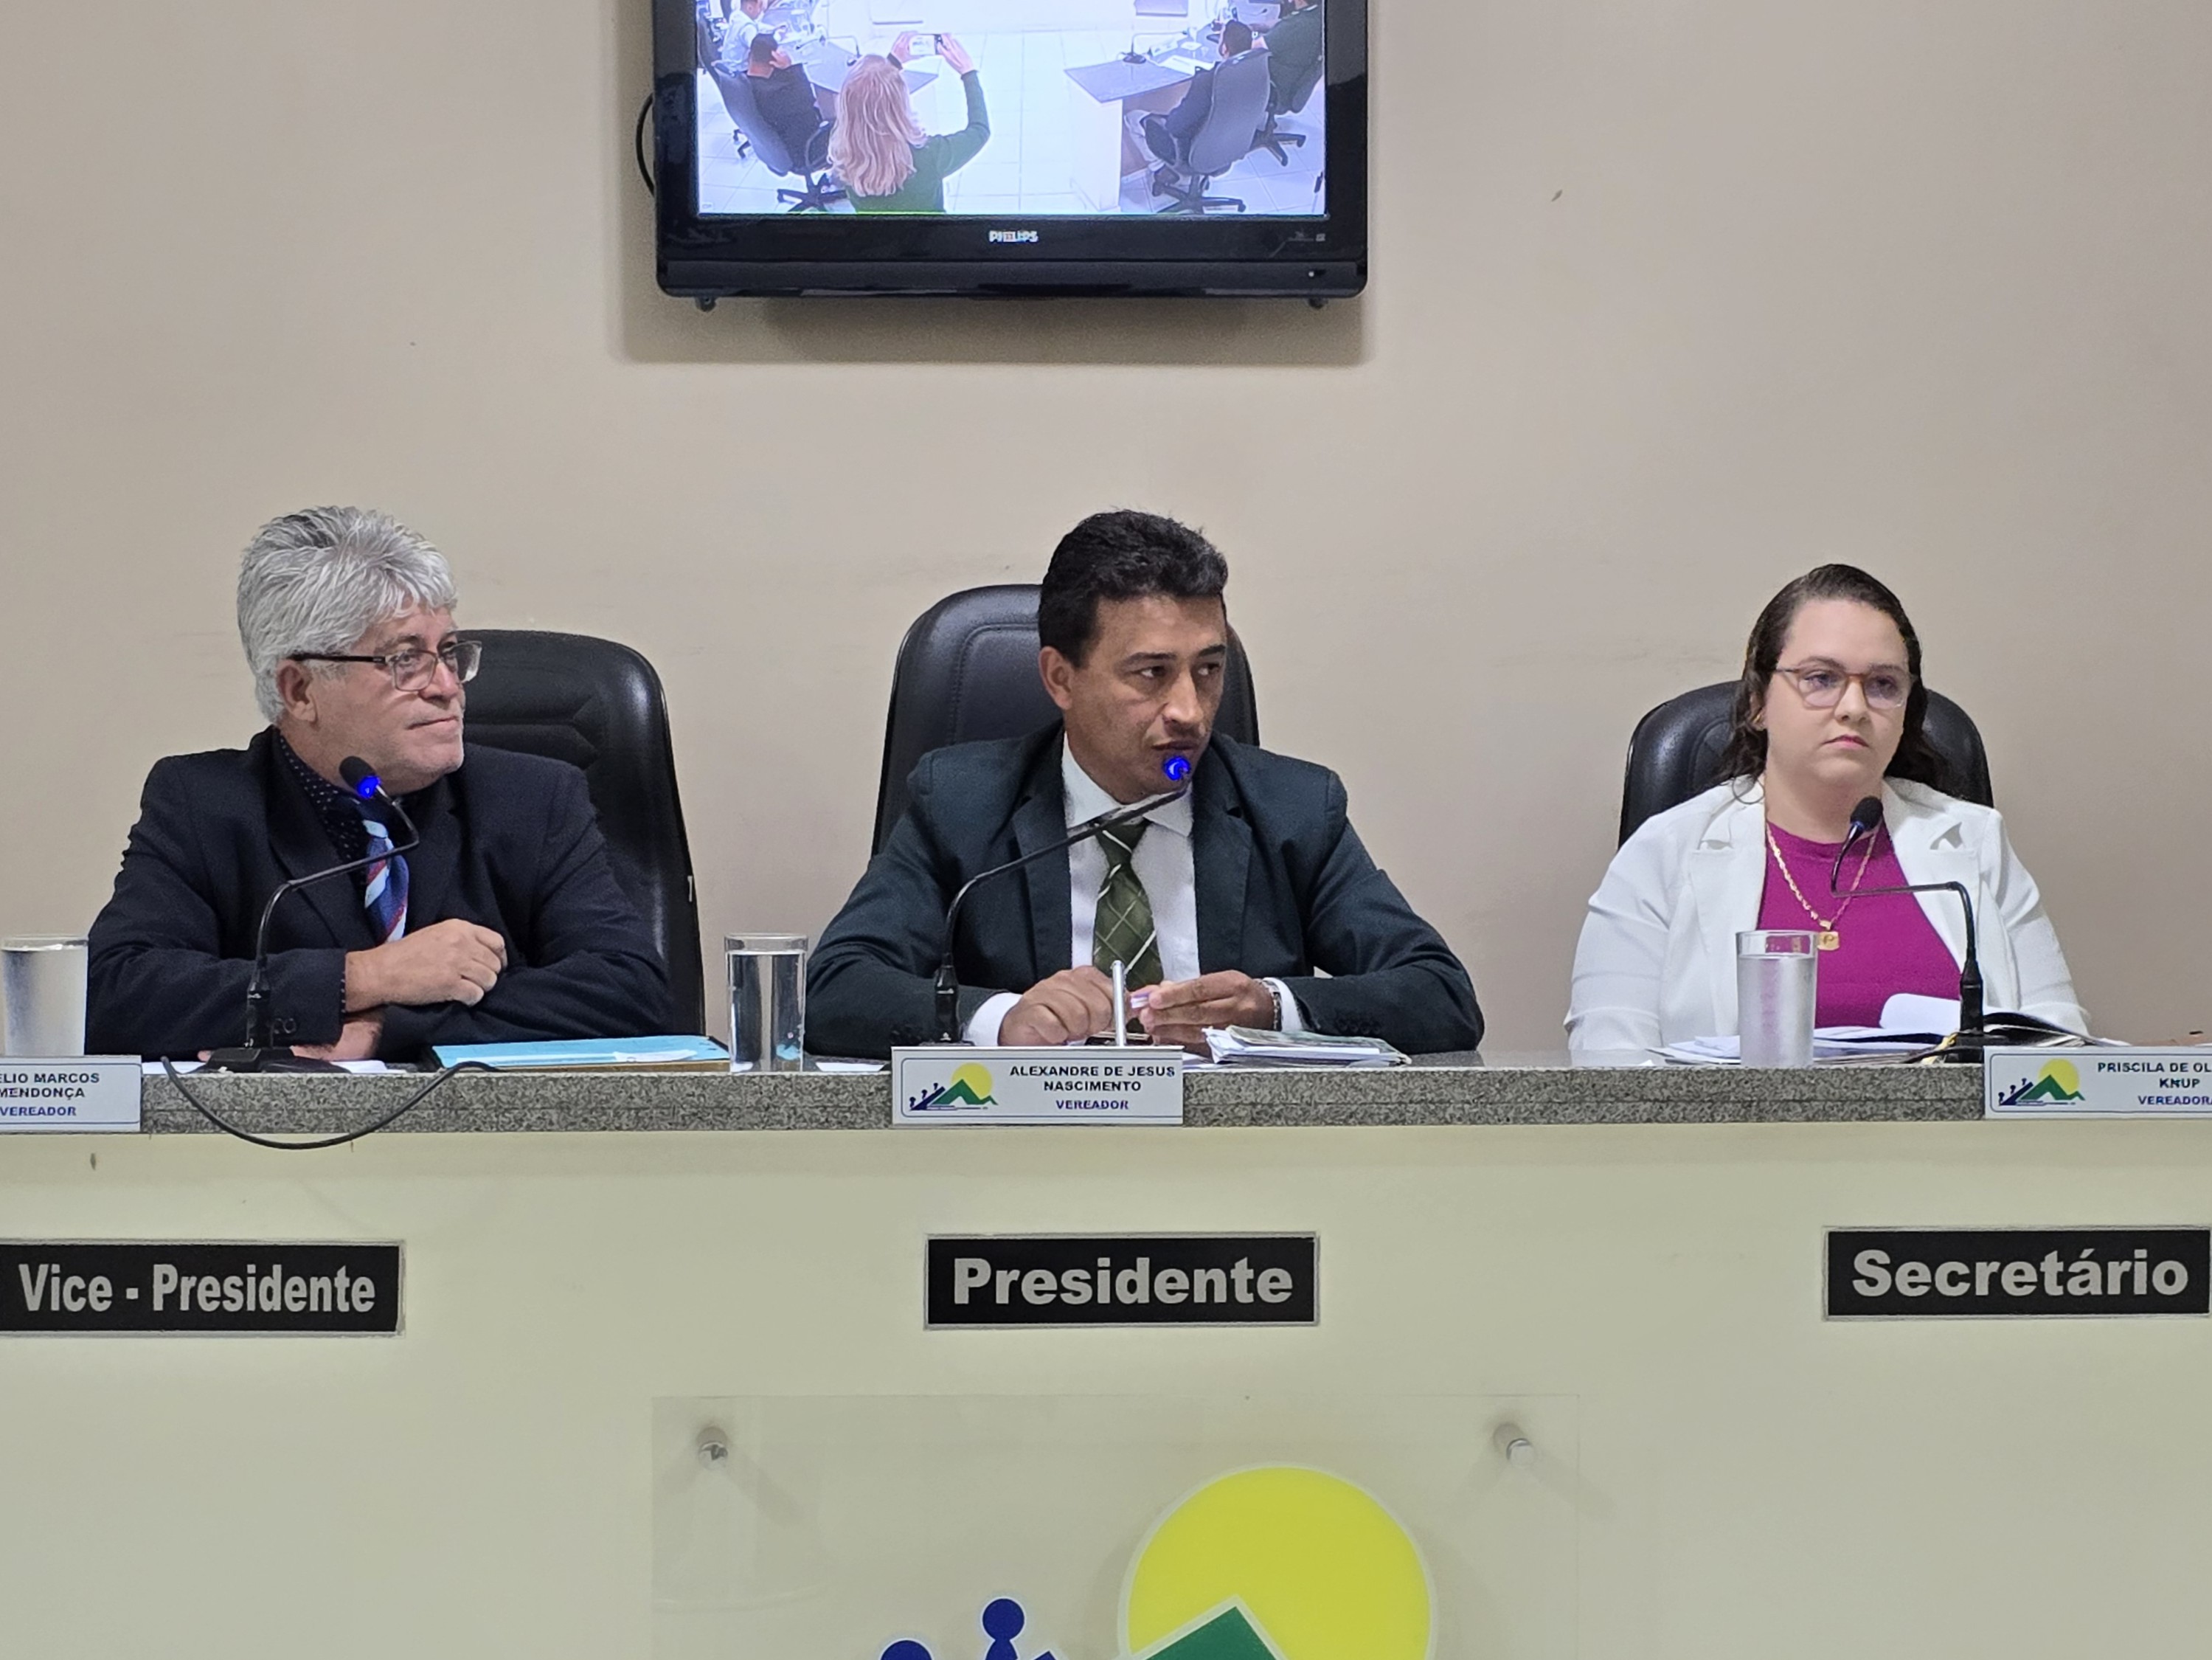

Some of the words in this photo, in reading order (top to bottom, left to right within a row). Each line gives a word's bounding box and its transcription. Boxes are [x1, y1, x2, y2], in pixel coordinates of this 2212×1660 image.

[1010, 1065, 1099, 1076] ALEXANDRE
[1103, 1065, 1123, 1076] DE
[1127, 1065, 1175, 1076] JESUS
[2097, 1062, 2165, 1073] PRISCILA
[2169, 1062, 2189, 1073] DE
[34, 1073, 100, 1083] MARCOS
[2159, 1078, 2200, 1088] KNUP
[1044, 1081, 1142, 1091] NASCIMENTO
[0, 1087, 86, 1100] MENDONÇA
[1055, 1099, 1129, 1110] VEREADOR
[0, 1107, 77, 1116] VEREADOR
[1852, 1248, 2188, 1296] Secretário
[954, 1257, 1293, 1304] Presidente
[18, 1264, 113, 1312] Vice
[153, 1264, 375, 1312] Presidente
